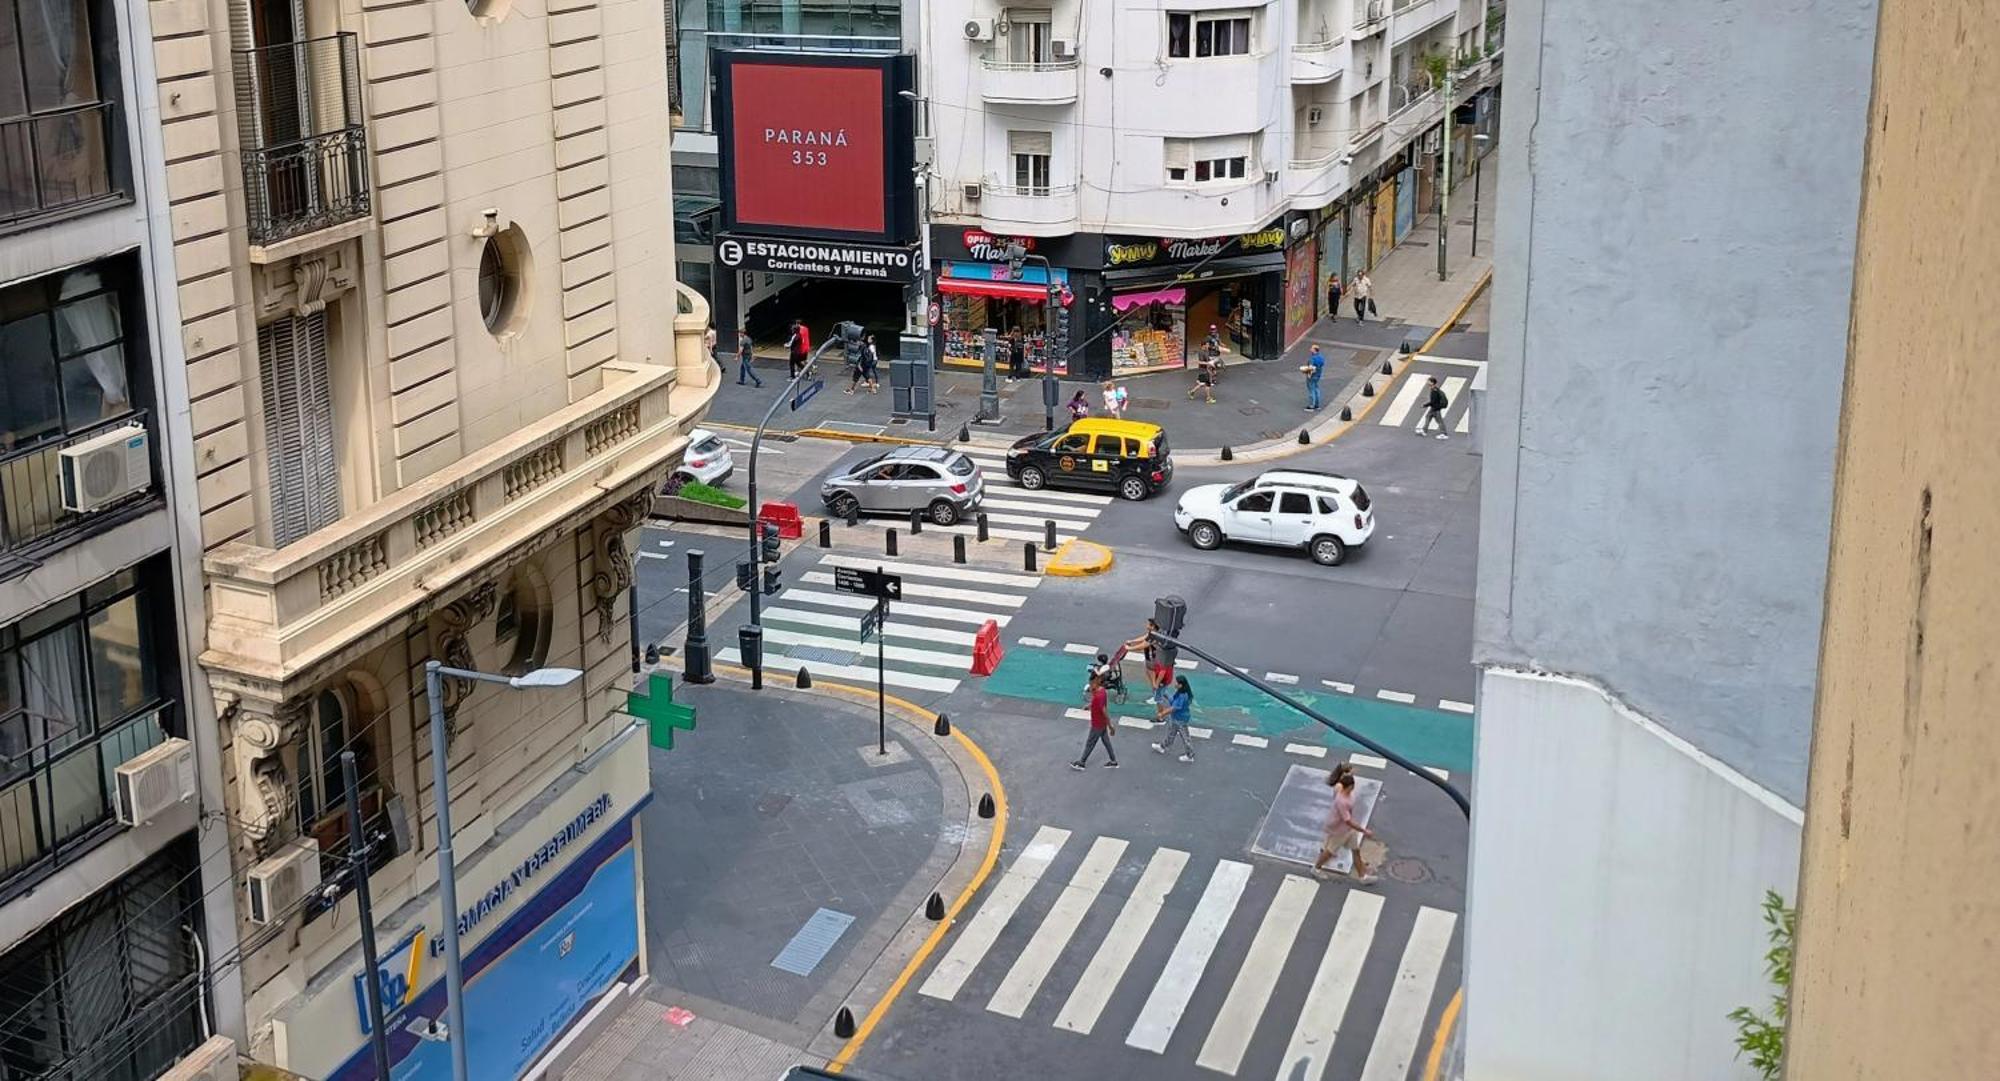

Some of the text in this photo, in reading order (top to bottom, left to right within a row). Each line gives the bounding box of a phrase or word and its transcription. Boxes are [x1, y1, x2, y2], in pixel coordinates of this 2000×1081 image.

[765, 129, 848, 146] PARANÁ
[792, 151, 828, 166] 353
[747, 242, 908, 267] ESTACIONAMIENTO
[1168, 241, 1222, 259] Market
[767, 258, 888, 278] Corrientes y Paraná
[432, 874, 514, 956] FRMACIA
